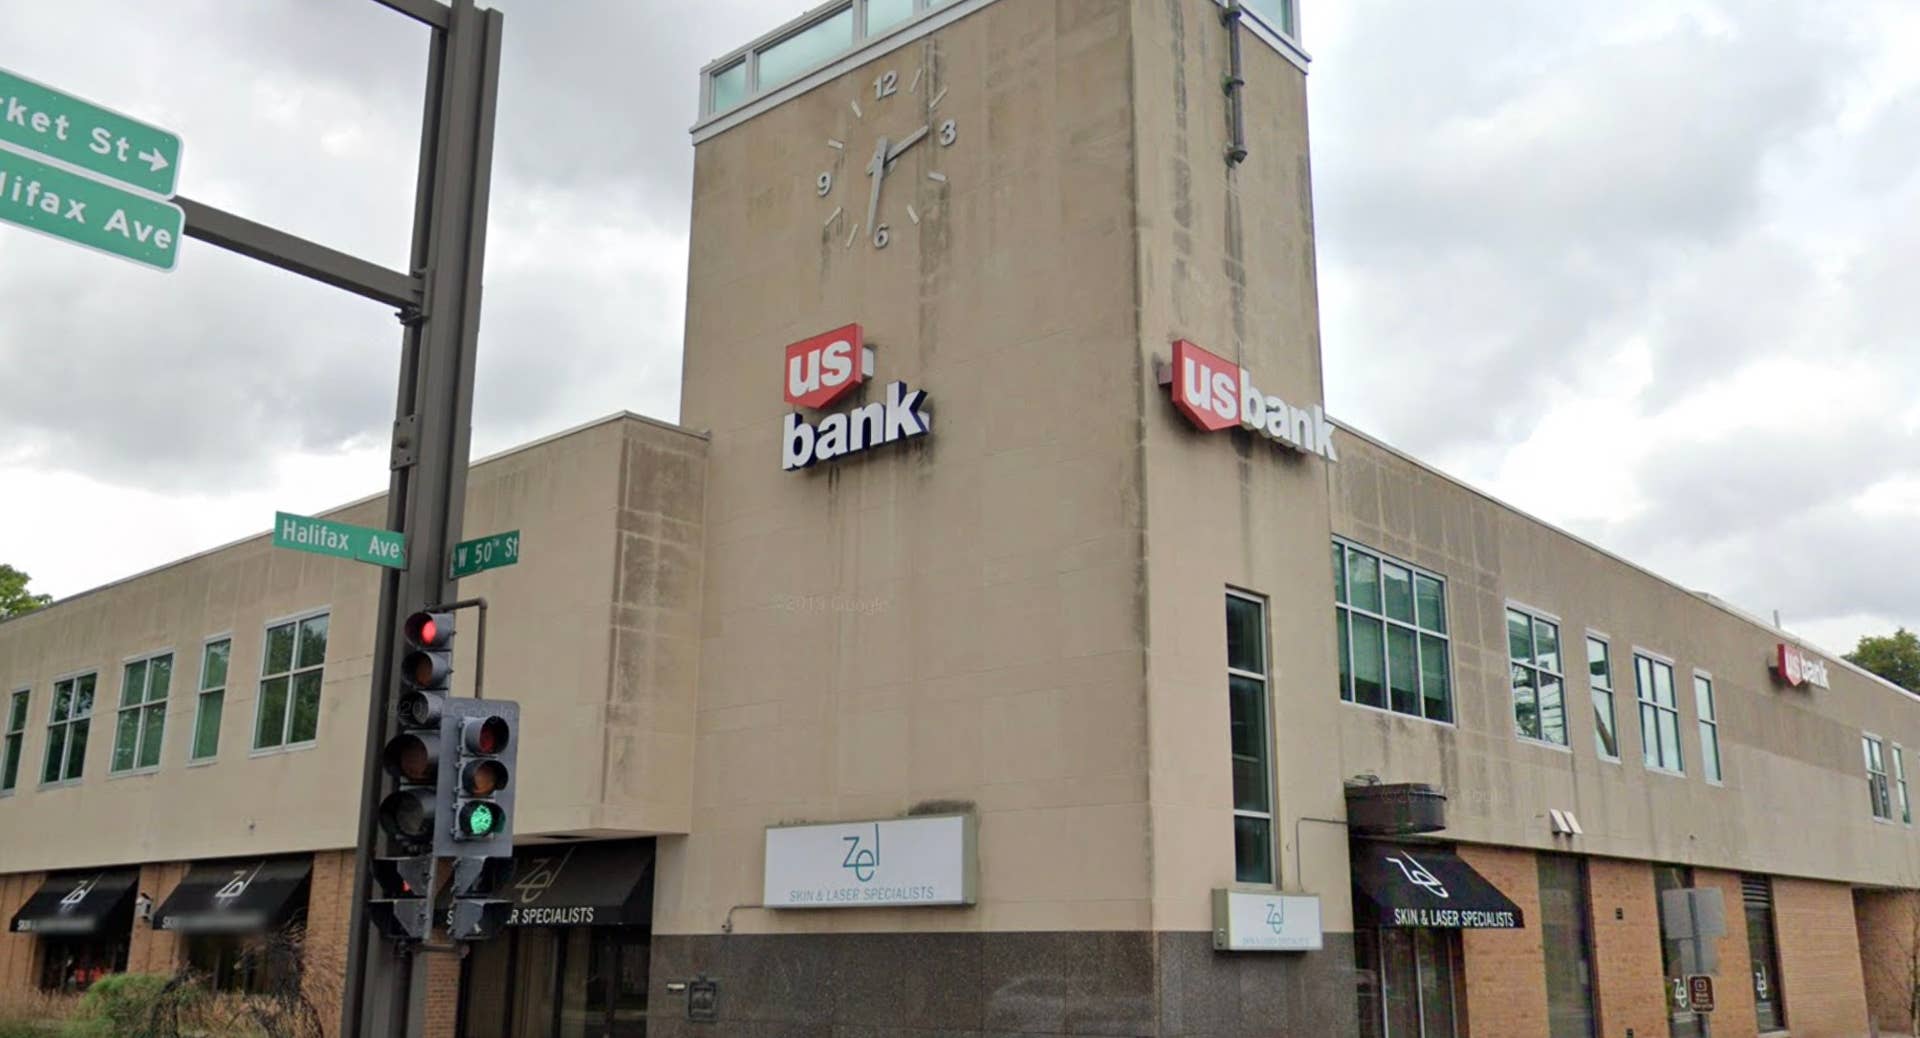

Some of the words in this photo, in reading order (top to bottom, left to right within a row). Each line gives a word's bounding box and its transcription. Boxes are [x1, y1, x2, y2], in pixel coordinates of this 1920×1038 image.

[874, 70, 899, 100] 12
[0, 97, 70, 141] ket
[89, 127, 130, 162] St
[939, 119, 957, 146] 3
[817, 171, 832, 197] 9
[104, 208, 172, 249] Ave
[874, 224, 890, 249] 6
[782, 380, 926, 470] bank
[282, 519, 350, 551] Halifax
[368, 535, 400, 559] Ave
[504, 537, 518, 558] St
[790, 890, 814, 901] SKIN
[815, 890, 823, 901] &
[827, 888, 860, 901] LASER
[863, 886, 934, 900] SPECIALISTS
[521, 907, 594, 925] SPECIALISTS
[1394, 908, 1418, 926] SKIN
[1421, 911, 1429, 926] &
[1431, 909, 1459, 927] LASER
[1461, 910, 1515, 928] SPECIALISTS
